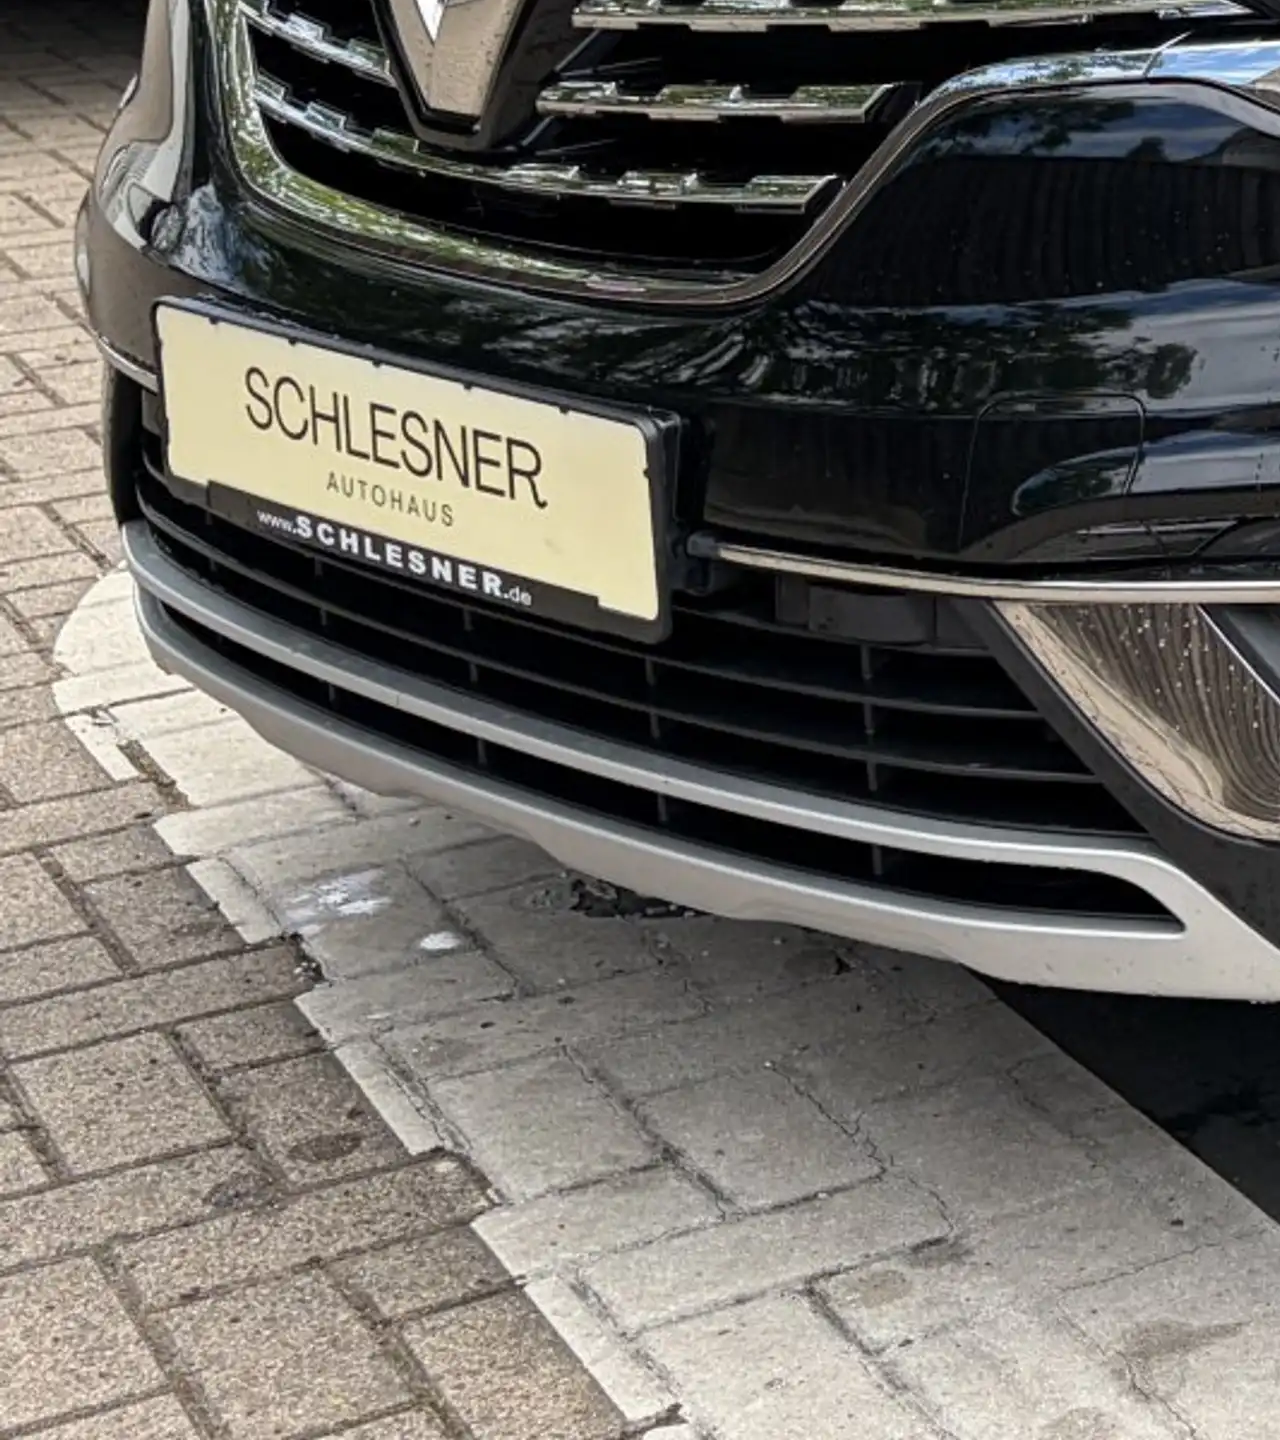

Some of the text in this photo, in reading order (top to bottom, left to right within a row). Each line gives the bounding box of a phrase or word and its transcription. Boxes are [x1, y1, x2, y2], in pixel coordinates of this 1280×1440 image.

[245, 366, 549, 510] SCHLESNER
[326, 471, 454, 528] AUTOHAUS
[257, 508, 533, 607] www.SCHLESNER.de
